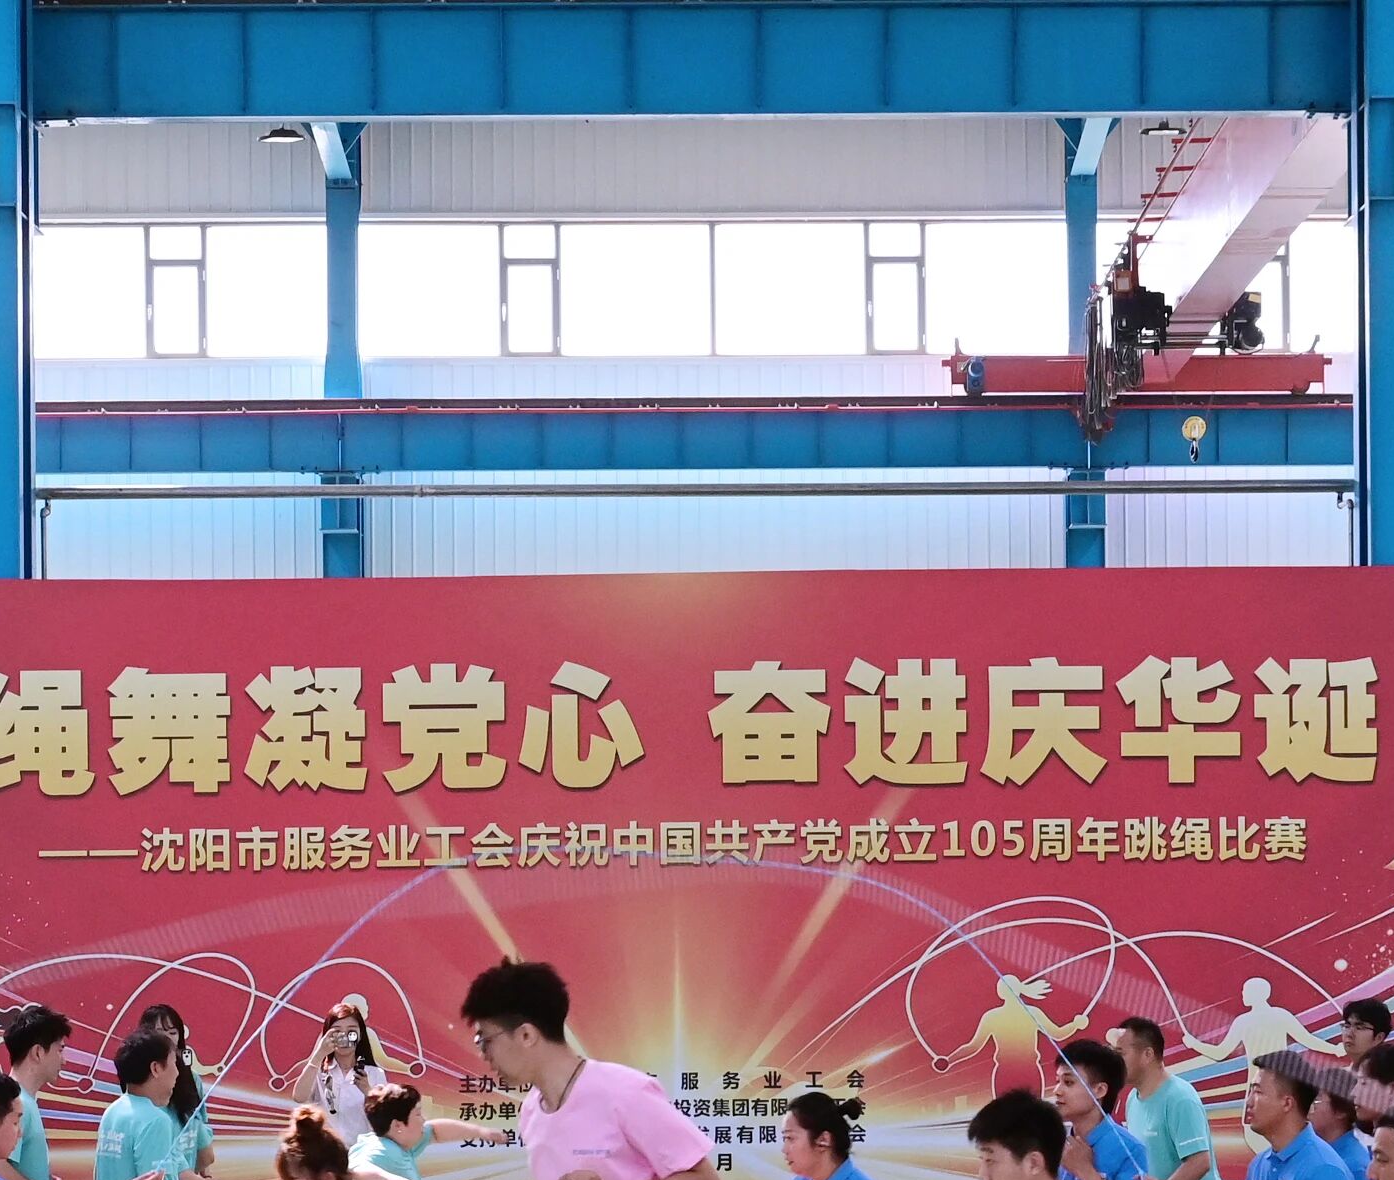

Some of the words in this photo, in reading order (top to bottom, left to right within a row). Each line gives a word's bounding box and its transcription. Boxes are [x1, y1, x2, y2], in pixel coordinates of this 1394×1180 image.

[707, 655, 1379, 787] 奋进庆华诞
